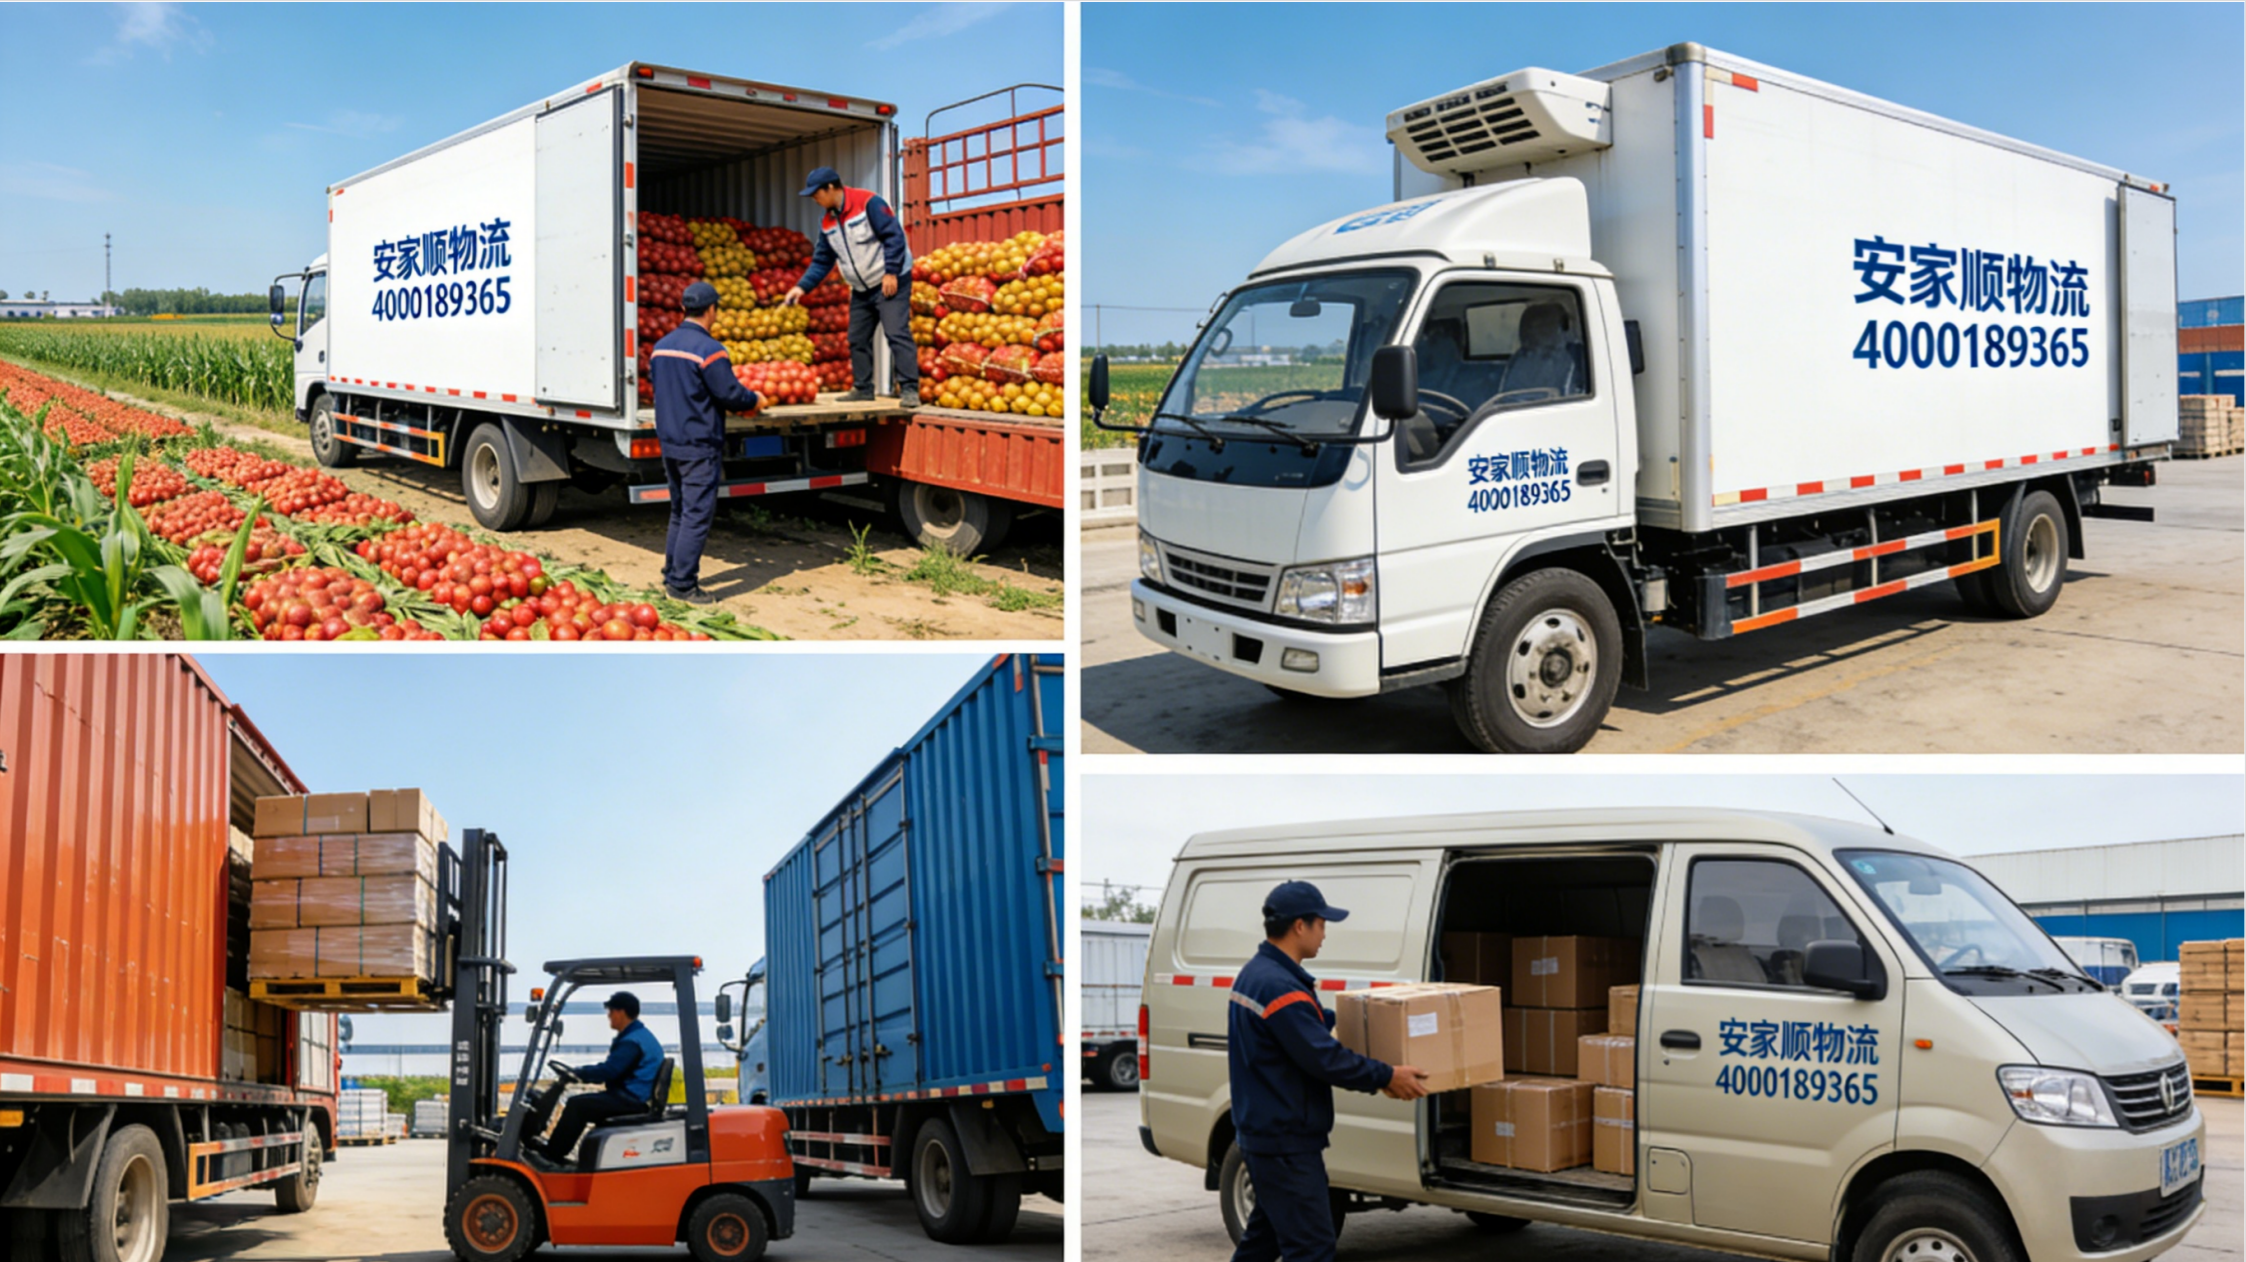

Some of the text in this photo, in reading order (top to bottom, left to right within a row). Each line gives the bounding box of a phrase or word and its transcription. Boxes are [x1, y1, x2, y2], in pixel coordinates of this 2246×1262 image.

[372, 217, 512, 284] 安家顺物流
[371, 276, 512, 322] 4000189365
[1852, 234, 2091, 318] 安家顺物流
[1852, 319, 2090, 370] 4000189365
[1467, 446, 1570, 486] 安家顺物流
[1467, 479, 1572, 514] 4000189365
[1718, 1017, 1880, 1066] 安家顺物流
[1715, 1064, 1879, 1106] 4000189365
